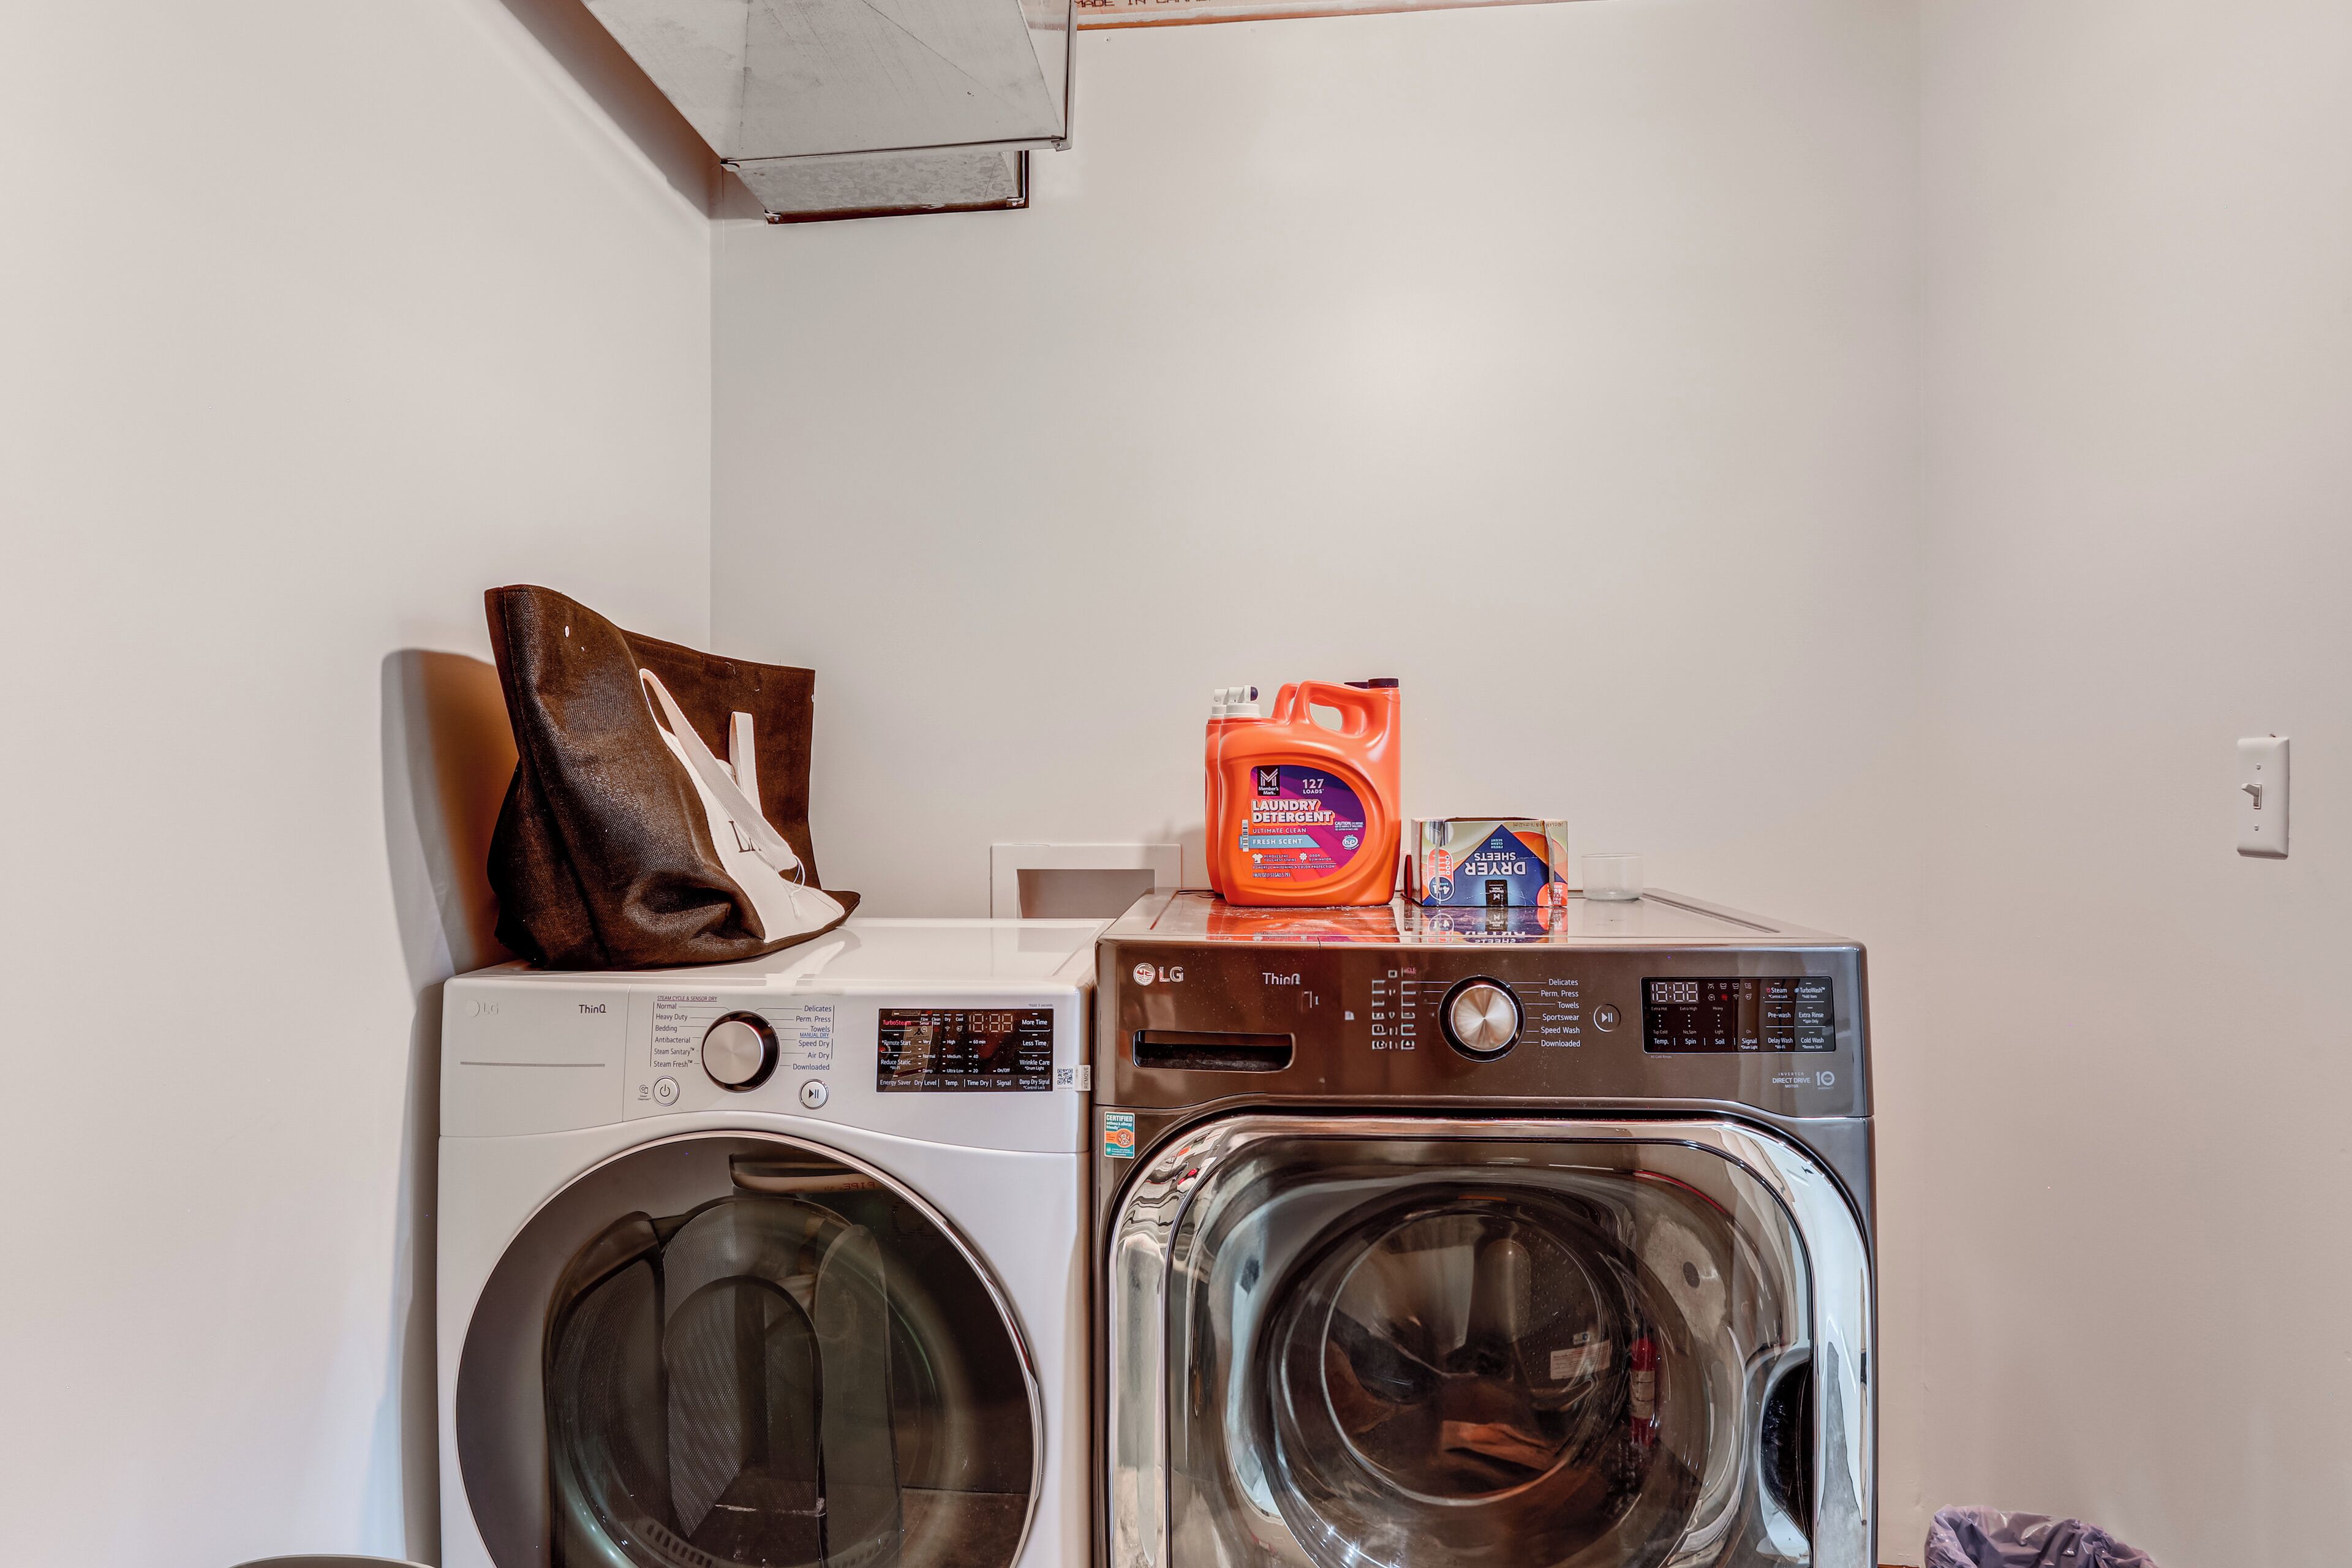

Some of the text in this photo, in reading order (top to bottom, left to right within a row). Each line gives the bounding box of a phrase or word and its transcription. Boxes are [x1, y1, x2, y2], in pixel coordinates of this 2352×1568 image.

[1303, 779, 1324, 788] 127
[1253, 800, 1317, 811] LAUNDRY
[1253, 812, 1332, 823] DETERGENT
[1475, 852, 1515, 861] SHEETS
[1465, 862, 1526, 875] DRYER
[1159, 967, 1183, 982] LG
[579, 1004, 606, 1014] ThinQ
[1816, 1071, 1835, 1086] 10
